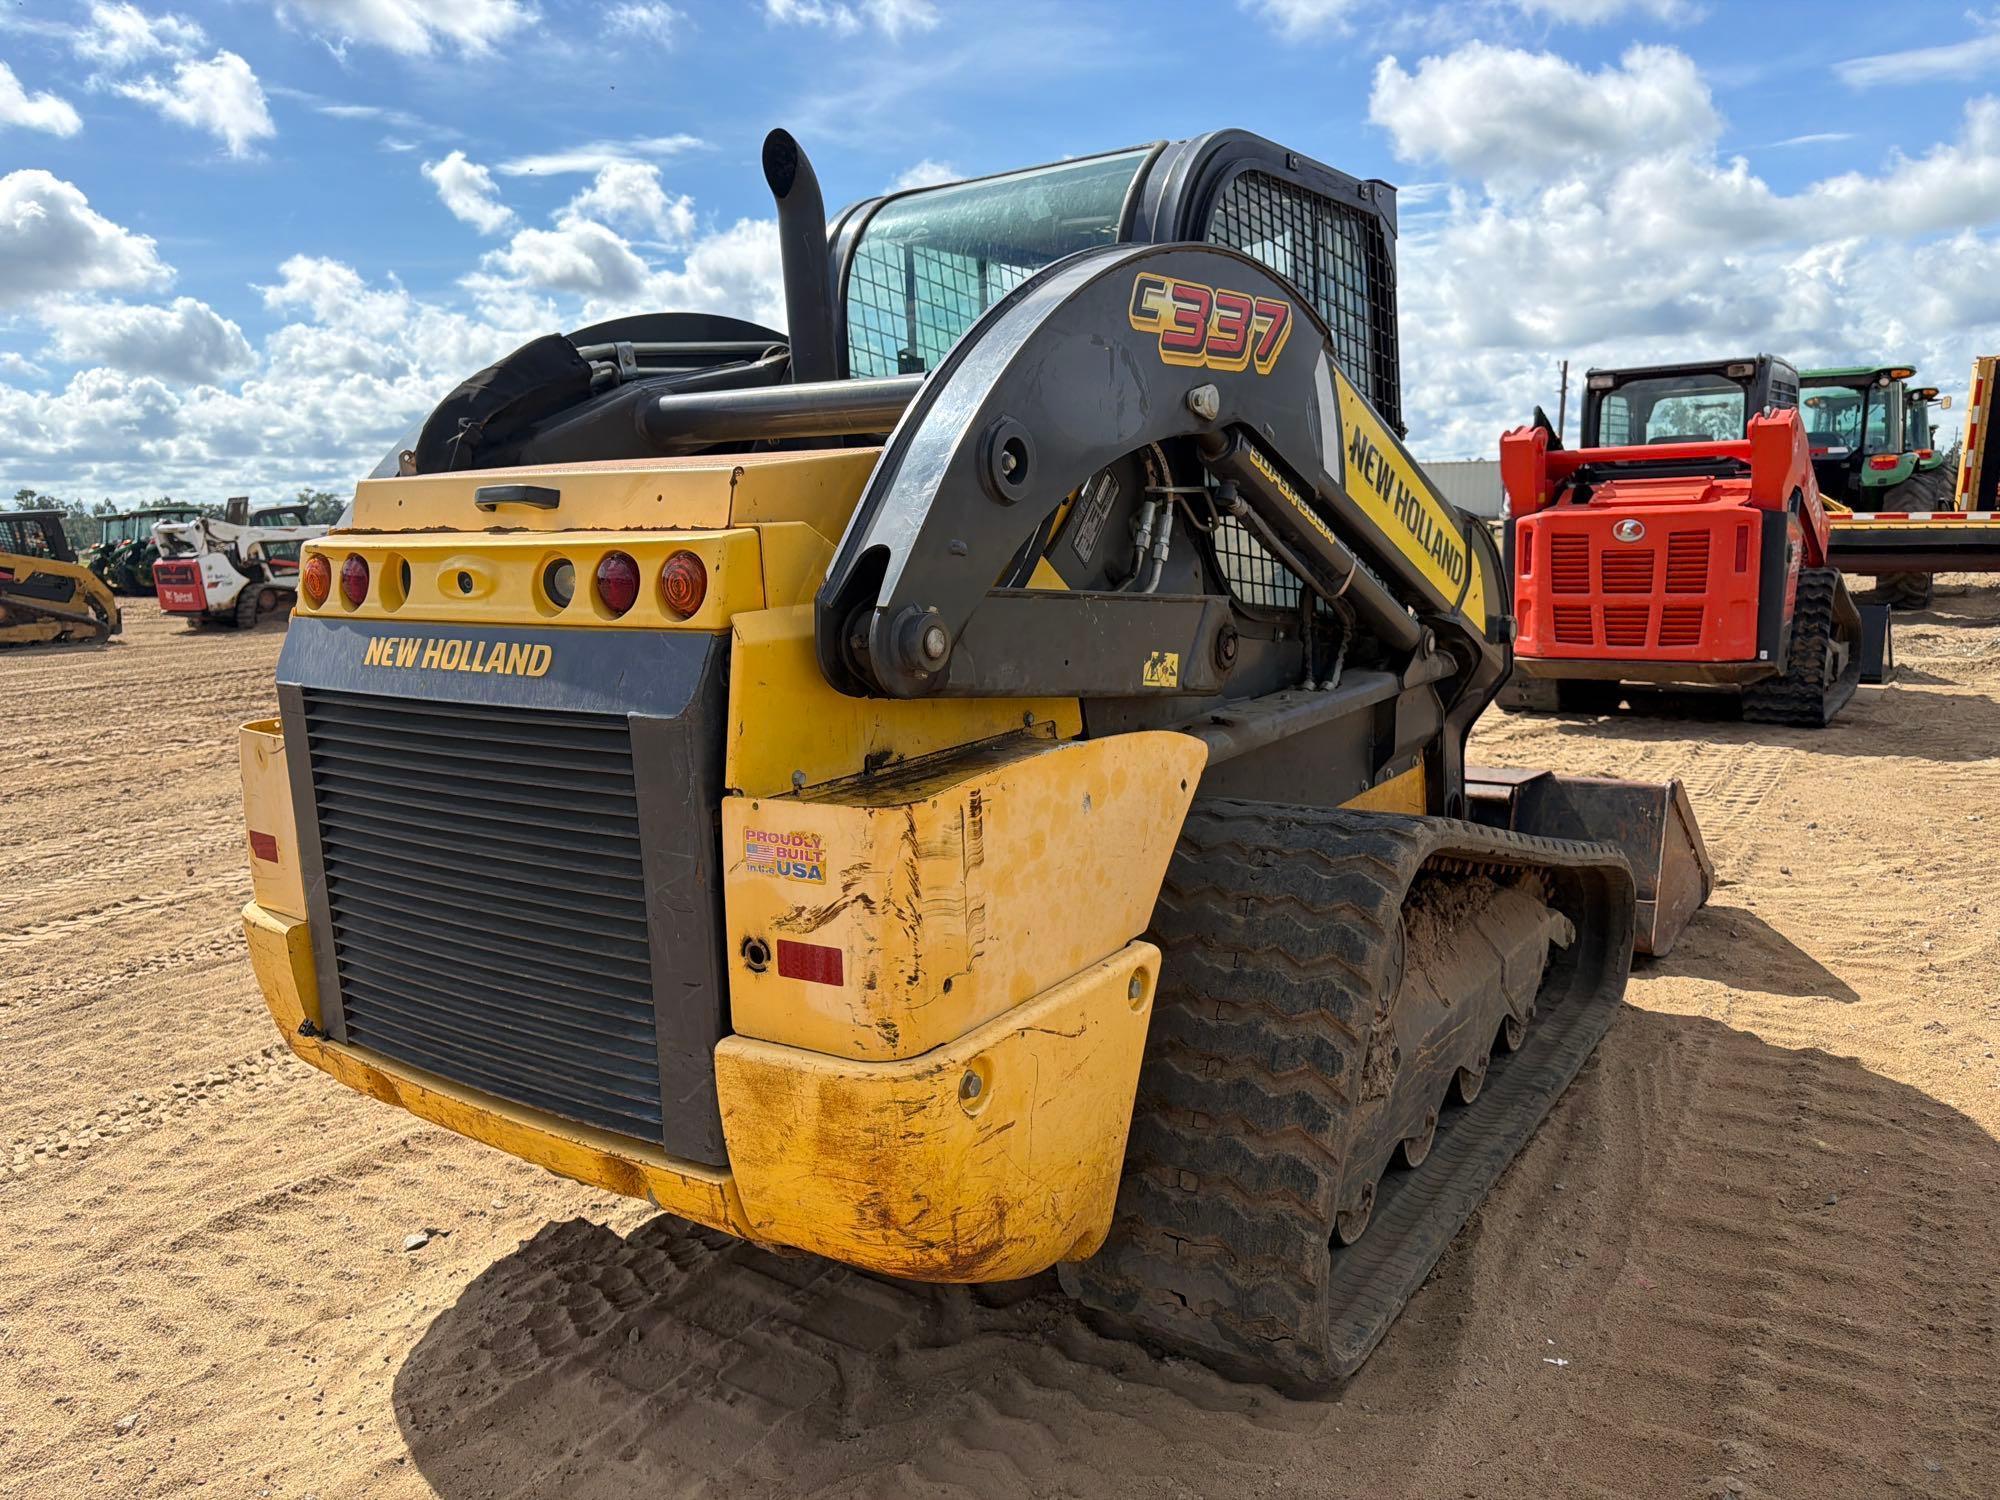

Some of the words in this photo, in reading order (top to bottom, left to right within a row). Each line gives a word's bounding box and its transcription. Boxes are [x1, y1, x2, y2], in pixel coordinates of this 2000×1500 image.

[1349, 424, 1396, 503] NEW
[1393, 479, 1464, 586] HOLLAND
[363, 636, 423, 668] NEW
[420, 638, 553, 677] HOLLAND
[745, 830, 823, 849] PROUDLY
[776, 846, 823, 862] BUILT
[777, 861, 823, 880] USA
